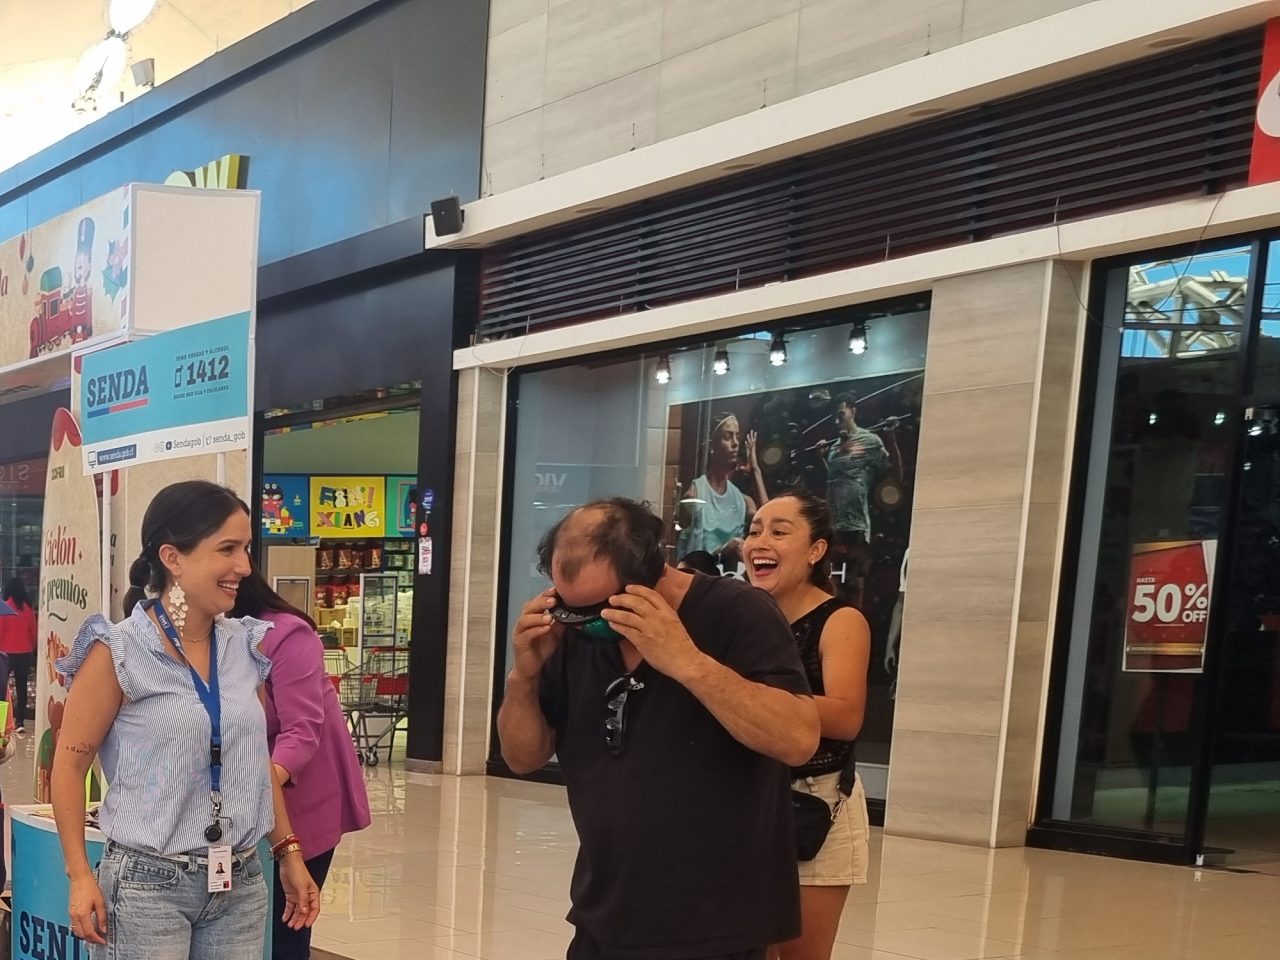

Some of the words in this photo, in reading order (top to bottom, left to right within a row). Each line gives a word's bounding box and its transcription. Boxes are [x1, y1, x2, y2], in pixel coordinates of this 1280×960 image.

[86, 365, 149, 408] SENDA
[186, 355, 230, 386] 1412
[316, 509, 380, 529] XIANG
[46, 574, 88, 612] premios
[1131, 583, 1208, 623] 50%
[1182, 610, 1208, 623] OFF
